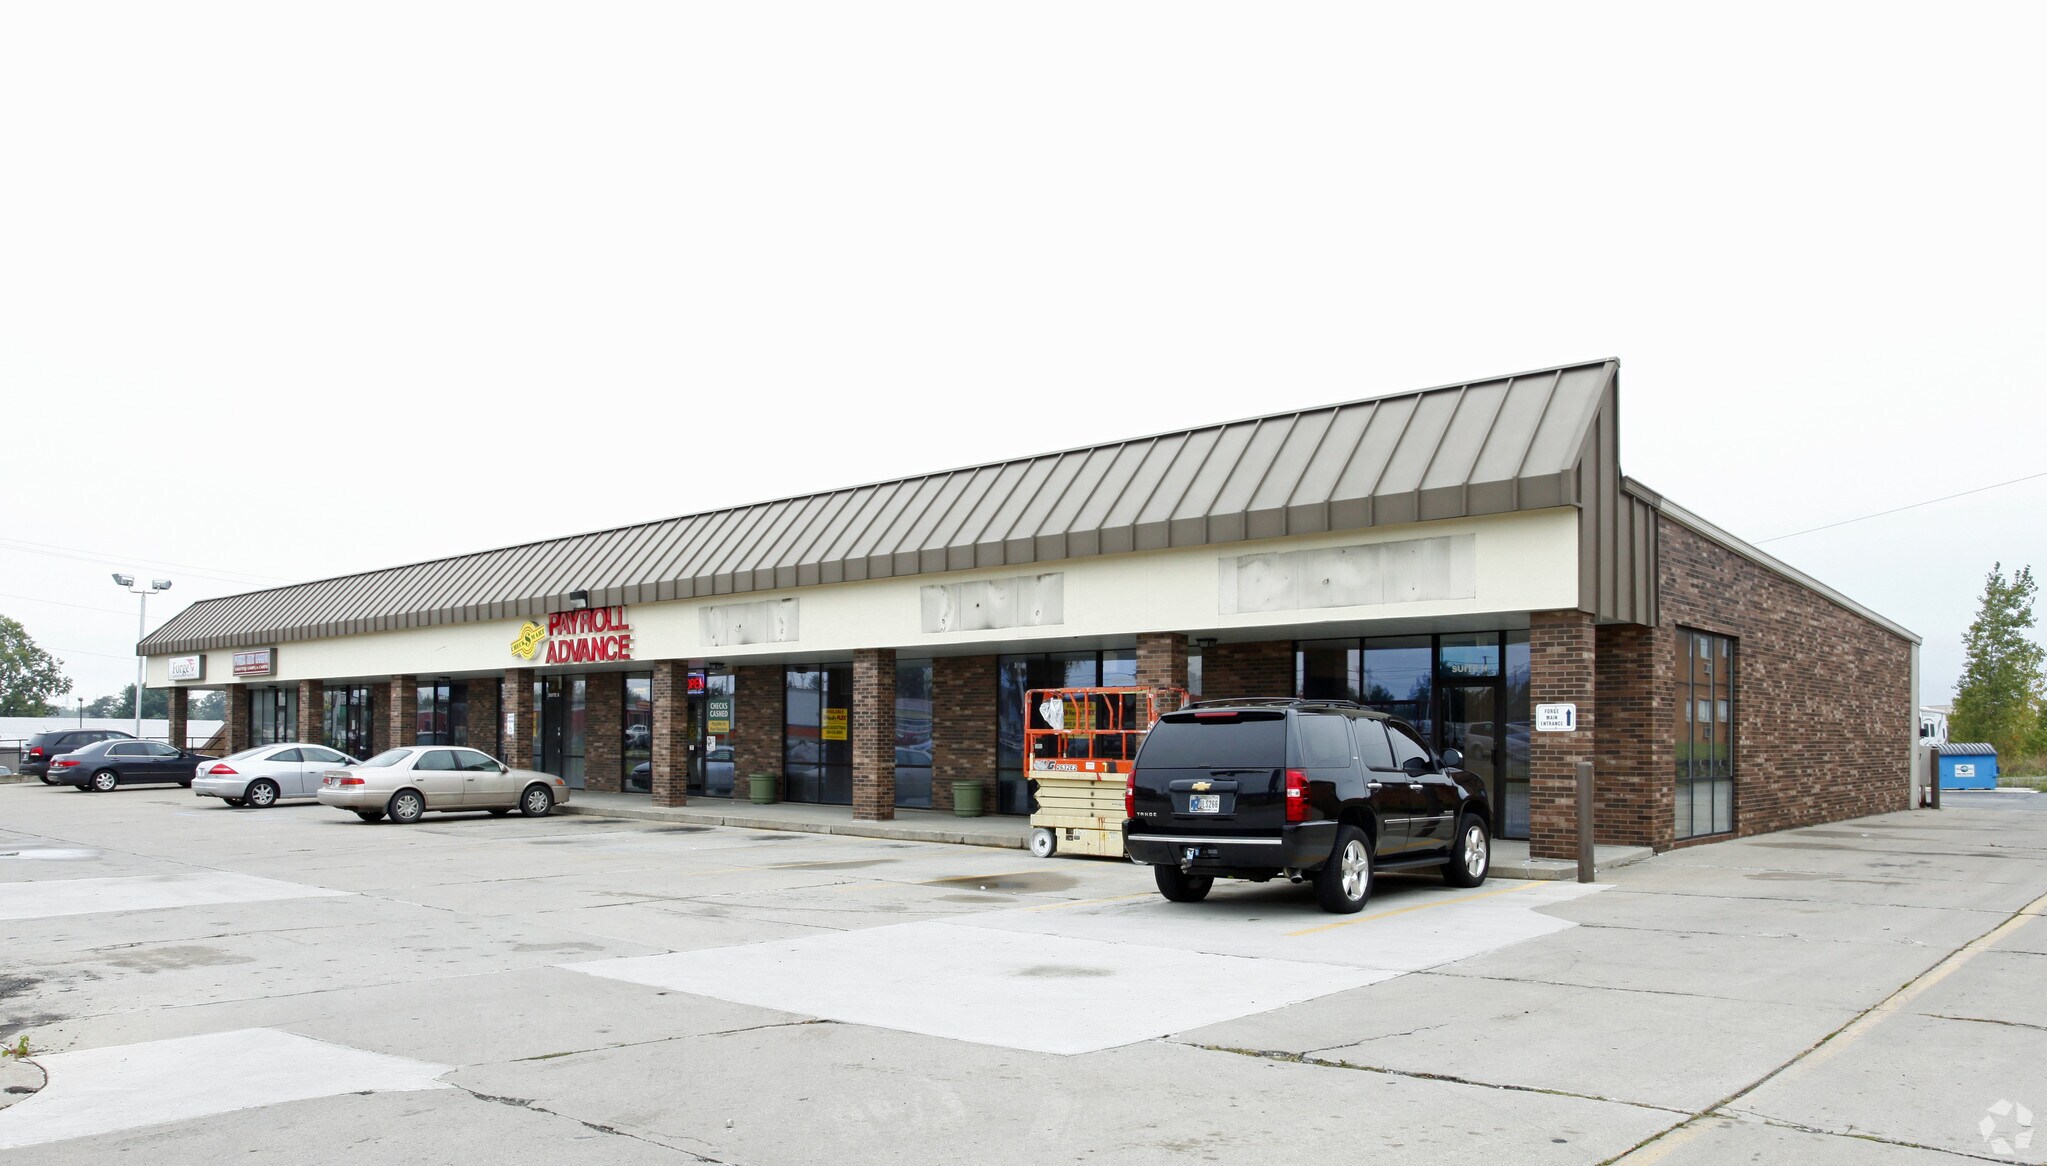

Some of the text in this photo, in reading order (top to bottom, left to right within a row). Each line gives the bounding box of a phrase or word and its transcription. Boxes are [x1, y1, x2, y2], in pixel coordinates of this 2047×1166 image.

[548, 606, 629, 636] PAYROLL
[545, 634, 631, 664] ADVANCE
[172, 662, 190, 677] Forge
[1451, 664, 1479, 673] SUITE
[710, 702, 728, 710] CHECKS
[709, 710, 729, 718] CASHED
